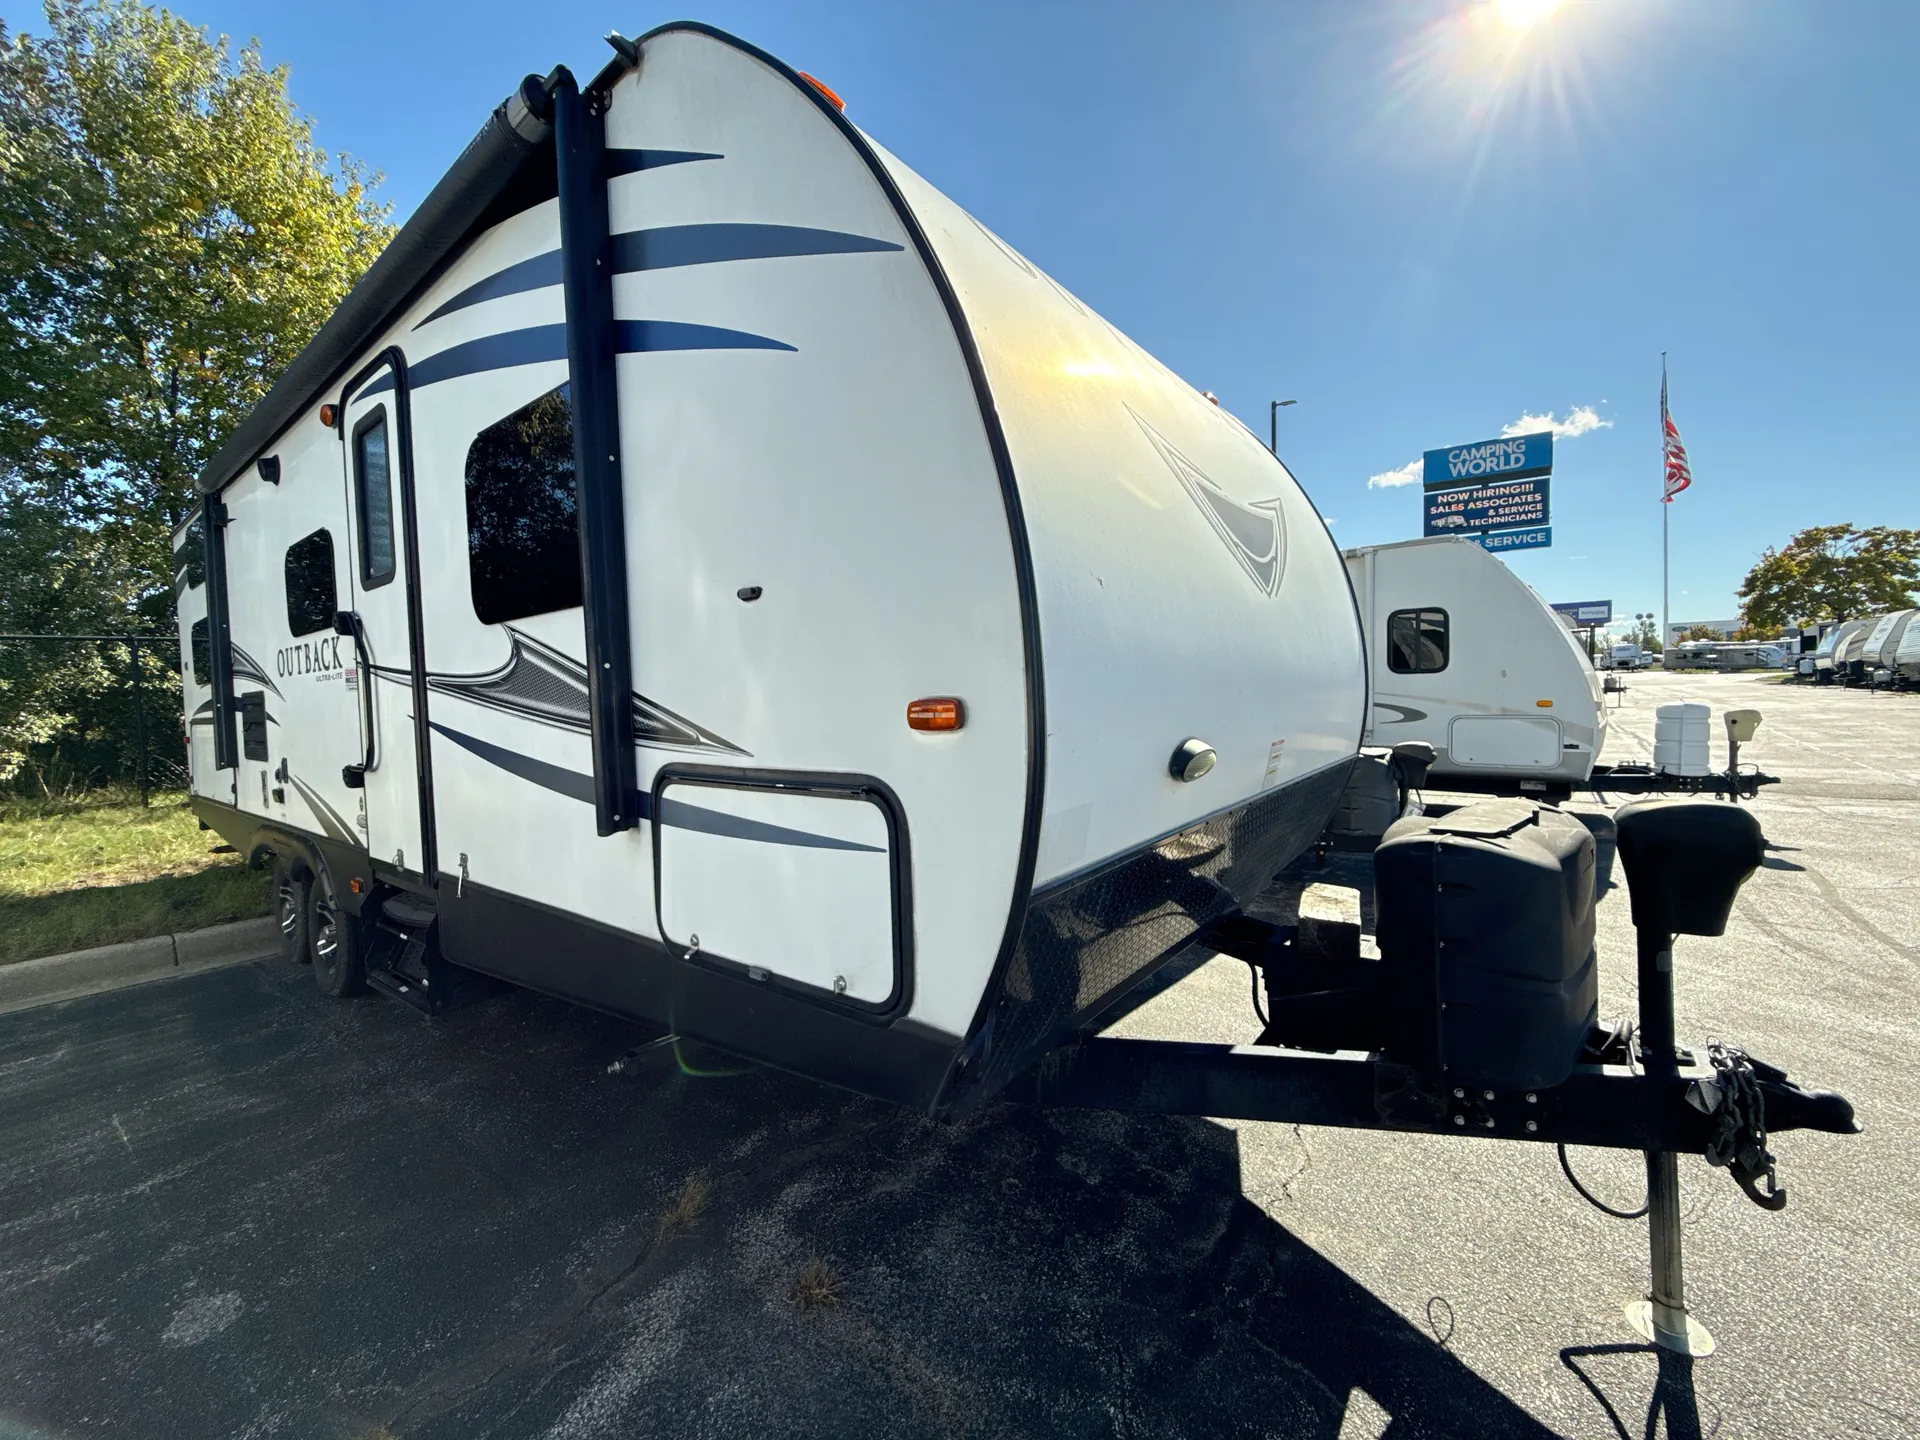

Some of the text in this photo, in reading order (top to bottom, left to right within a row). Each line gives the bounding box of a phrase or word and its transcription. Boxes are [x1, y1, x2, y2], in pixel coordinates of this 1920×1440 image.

[1448, 440, 1526, 463] CAMPING
[1448, 453, 1526, 477] WORLD
[1437, 483, 1534, 503] NOW HIRING!!!
[1430, 493, 1542, 514] SALES ASSOCIATES
[1498, 503, 1543, 514] SERVICE
[1469, 511, 1543, 526] TECHNICIANS
[1485, 532, 1546, 548] SERVICE
[277, 636, 343, 678] OUTBACK
[316, 672, 343, 682] ULTRA-LITE
